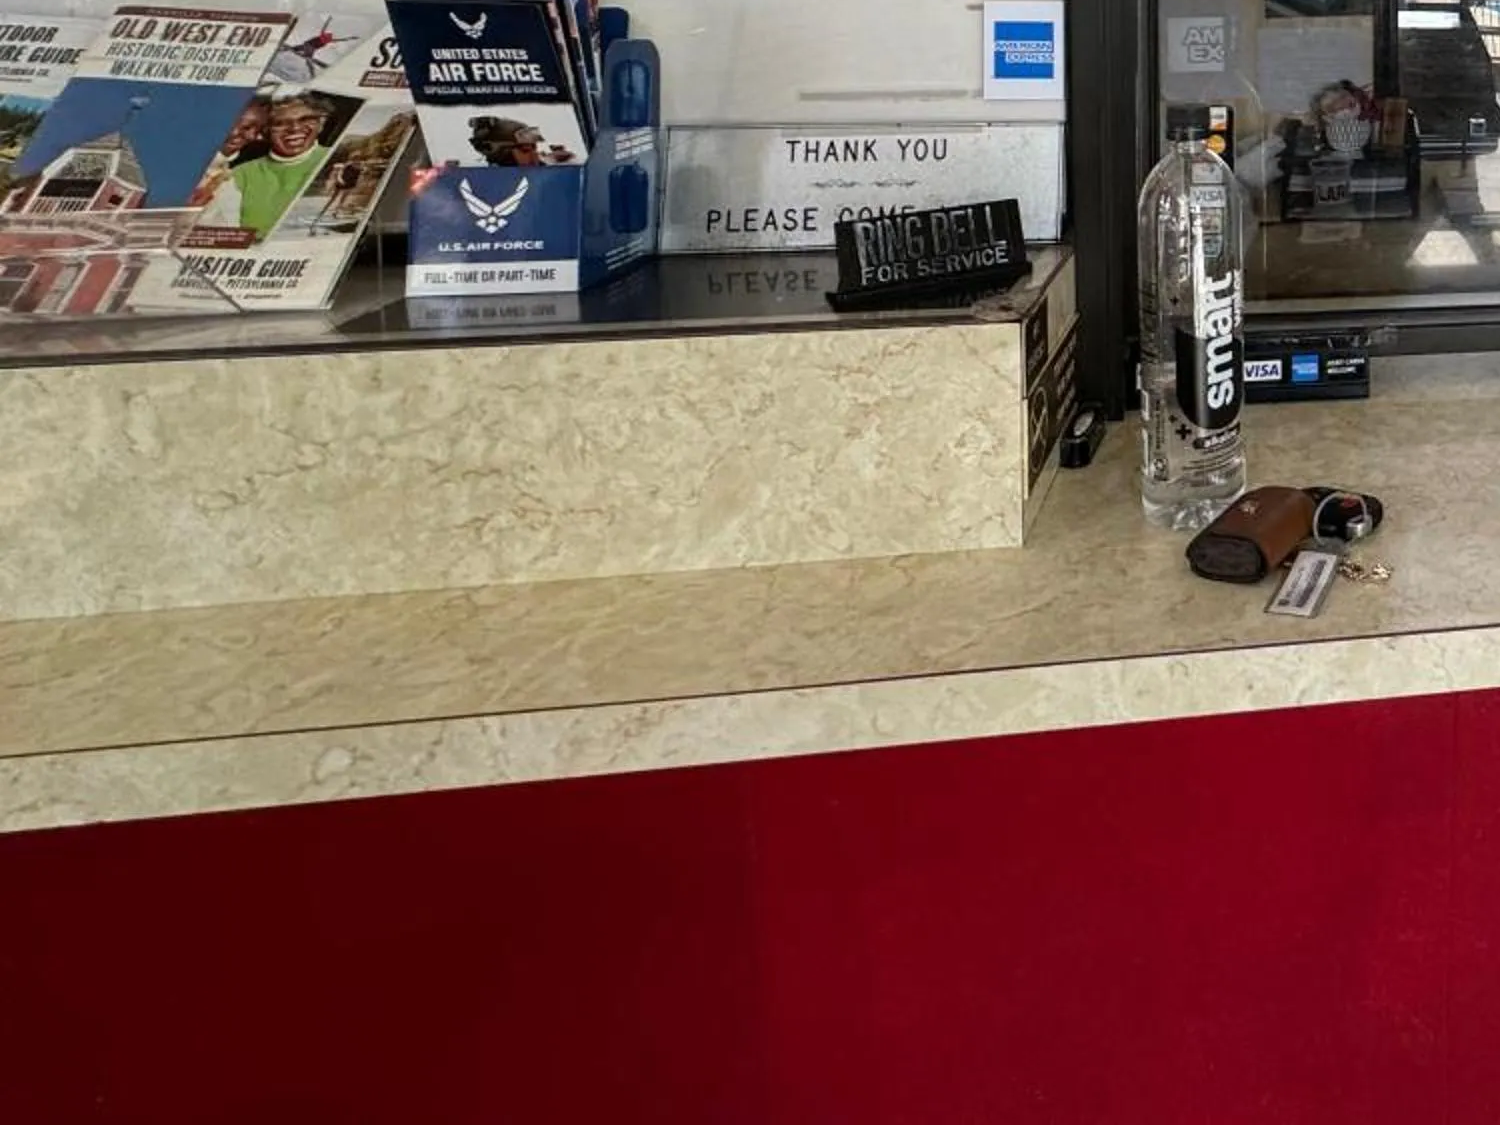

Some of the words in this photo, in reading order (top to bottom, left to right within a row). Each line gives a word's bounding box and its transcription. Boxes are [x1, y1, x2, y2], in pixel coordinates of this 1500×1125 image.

[110, 18, 159, 40] OLD
[160, 20, 227, 45] WEST
[225, 25, 273, 48] END
[27, 46, 88, 65] GUIDE
[105, 41, 182, 61] HISTORIC
[183, 45, 253, 64] DISTRICT
[431, 48, 481, 60] UNITED
[482, 48, 529, 61] STATES
[994, 40, 1053, 51] AMERICAN
[109, 59, 186, 78] WALKING
[187, 64, 231, 82] TOUR
[428, 62, 465, 83] AIR
[472, 62, 545, 83] FORCE
[423, 84, 465, 95] SPECIAL
[785, 138, 878, 163] THANK
[897, 138, 949, 162] YOU
[706, 207, 820, 234] PLEASE
[437, 242, 465, 253] U.S.
[466, 242, 491, 252] AIR
[493, 240, 545, 252] FORCE
[853, 216, 926, 266] RING
[930, 205, 1008, 257] BELL
[180, 255, 257, 277] VISITOR
[257, 258, 311, 278] GUIDE
[481, 270, 498, 282] OR
[860, 262, 909, 286] FOR
[916, 245, 1010, 277] SERVICE
[1204, 271, 1235, 410] smart
[1244, 363, 1280, 378] VISA
